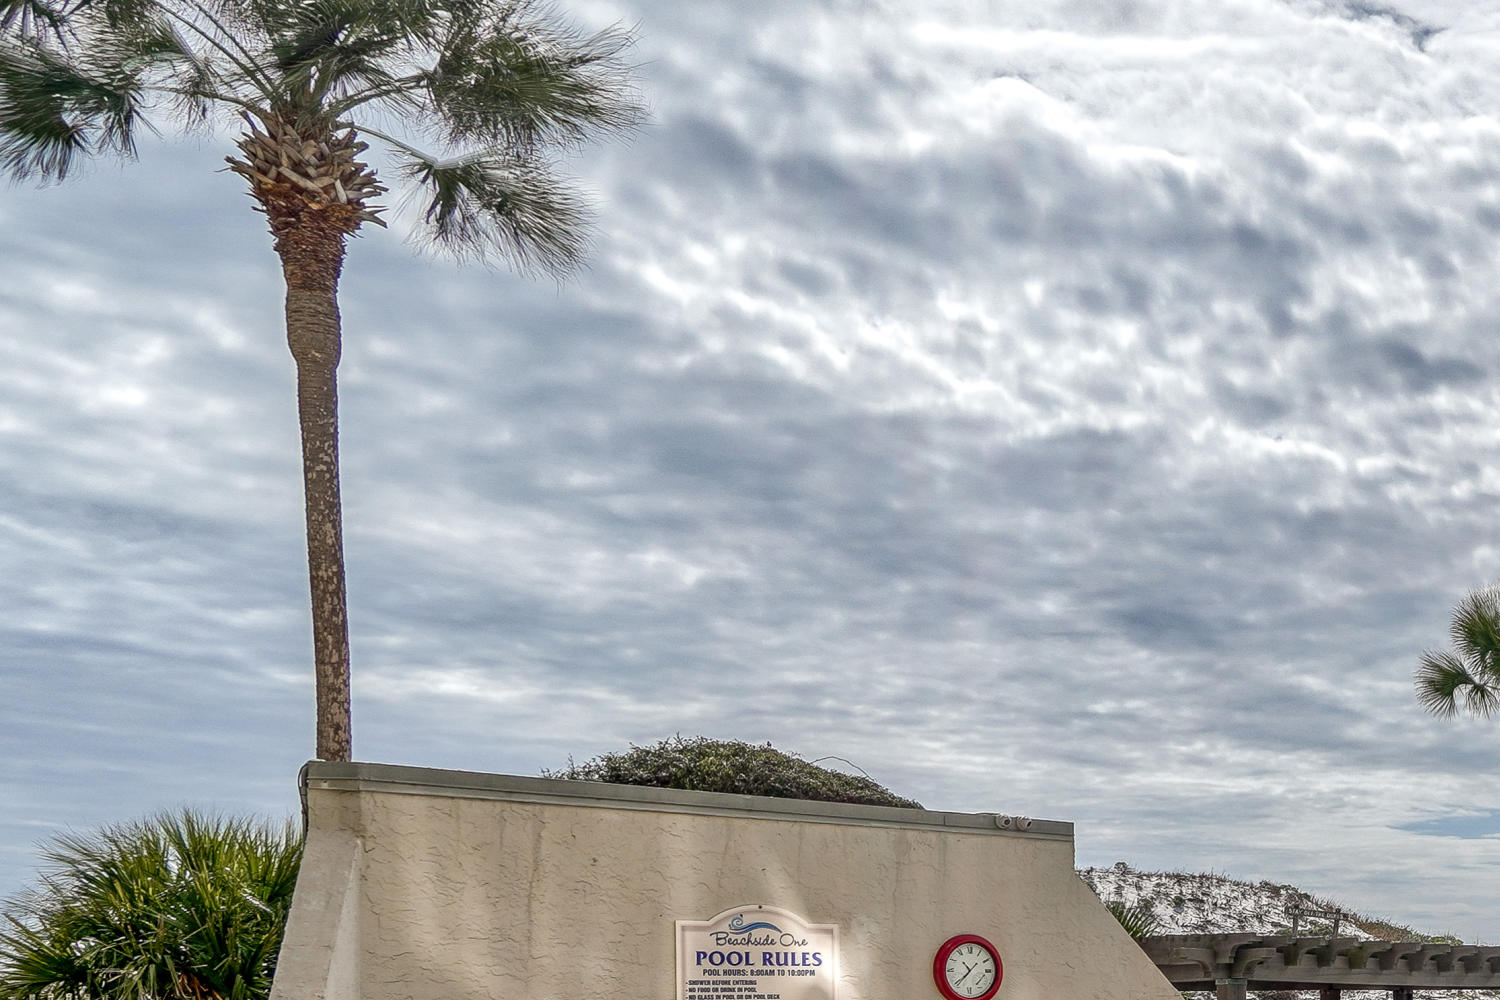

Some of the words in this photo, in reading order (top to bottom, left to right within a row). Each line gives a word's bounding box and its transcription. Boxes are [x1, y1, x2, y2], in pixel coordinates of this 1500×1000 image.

[710, 931, 777, 946] Beachside
[780, 933, 808, 947] One
[696, 951, 755, 966] POOL
[762, 951, 823, 967] RULES
[703, 968, 720, 976] POOL
